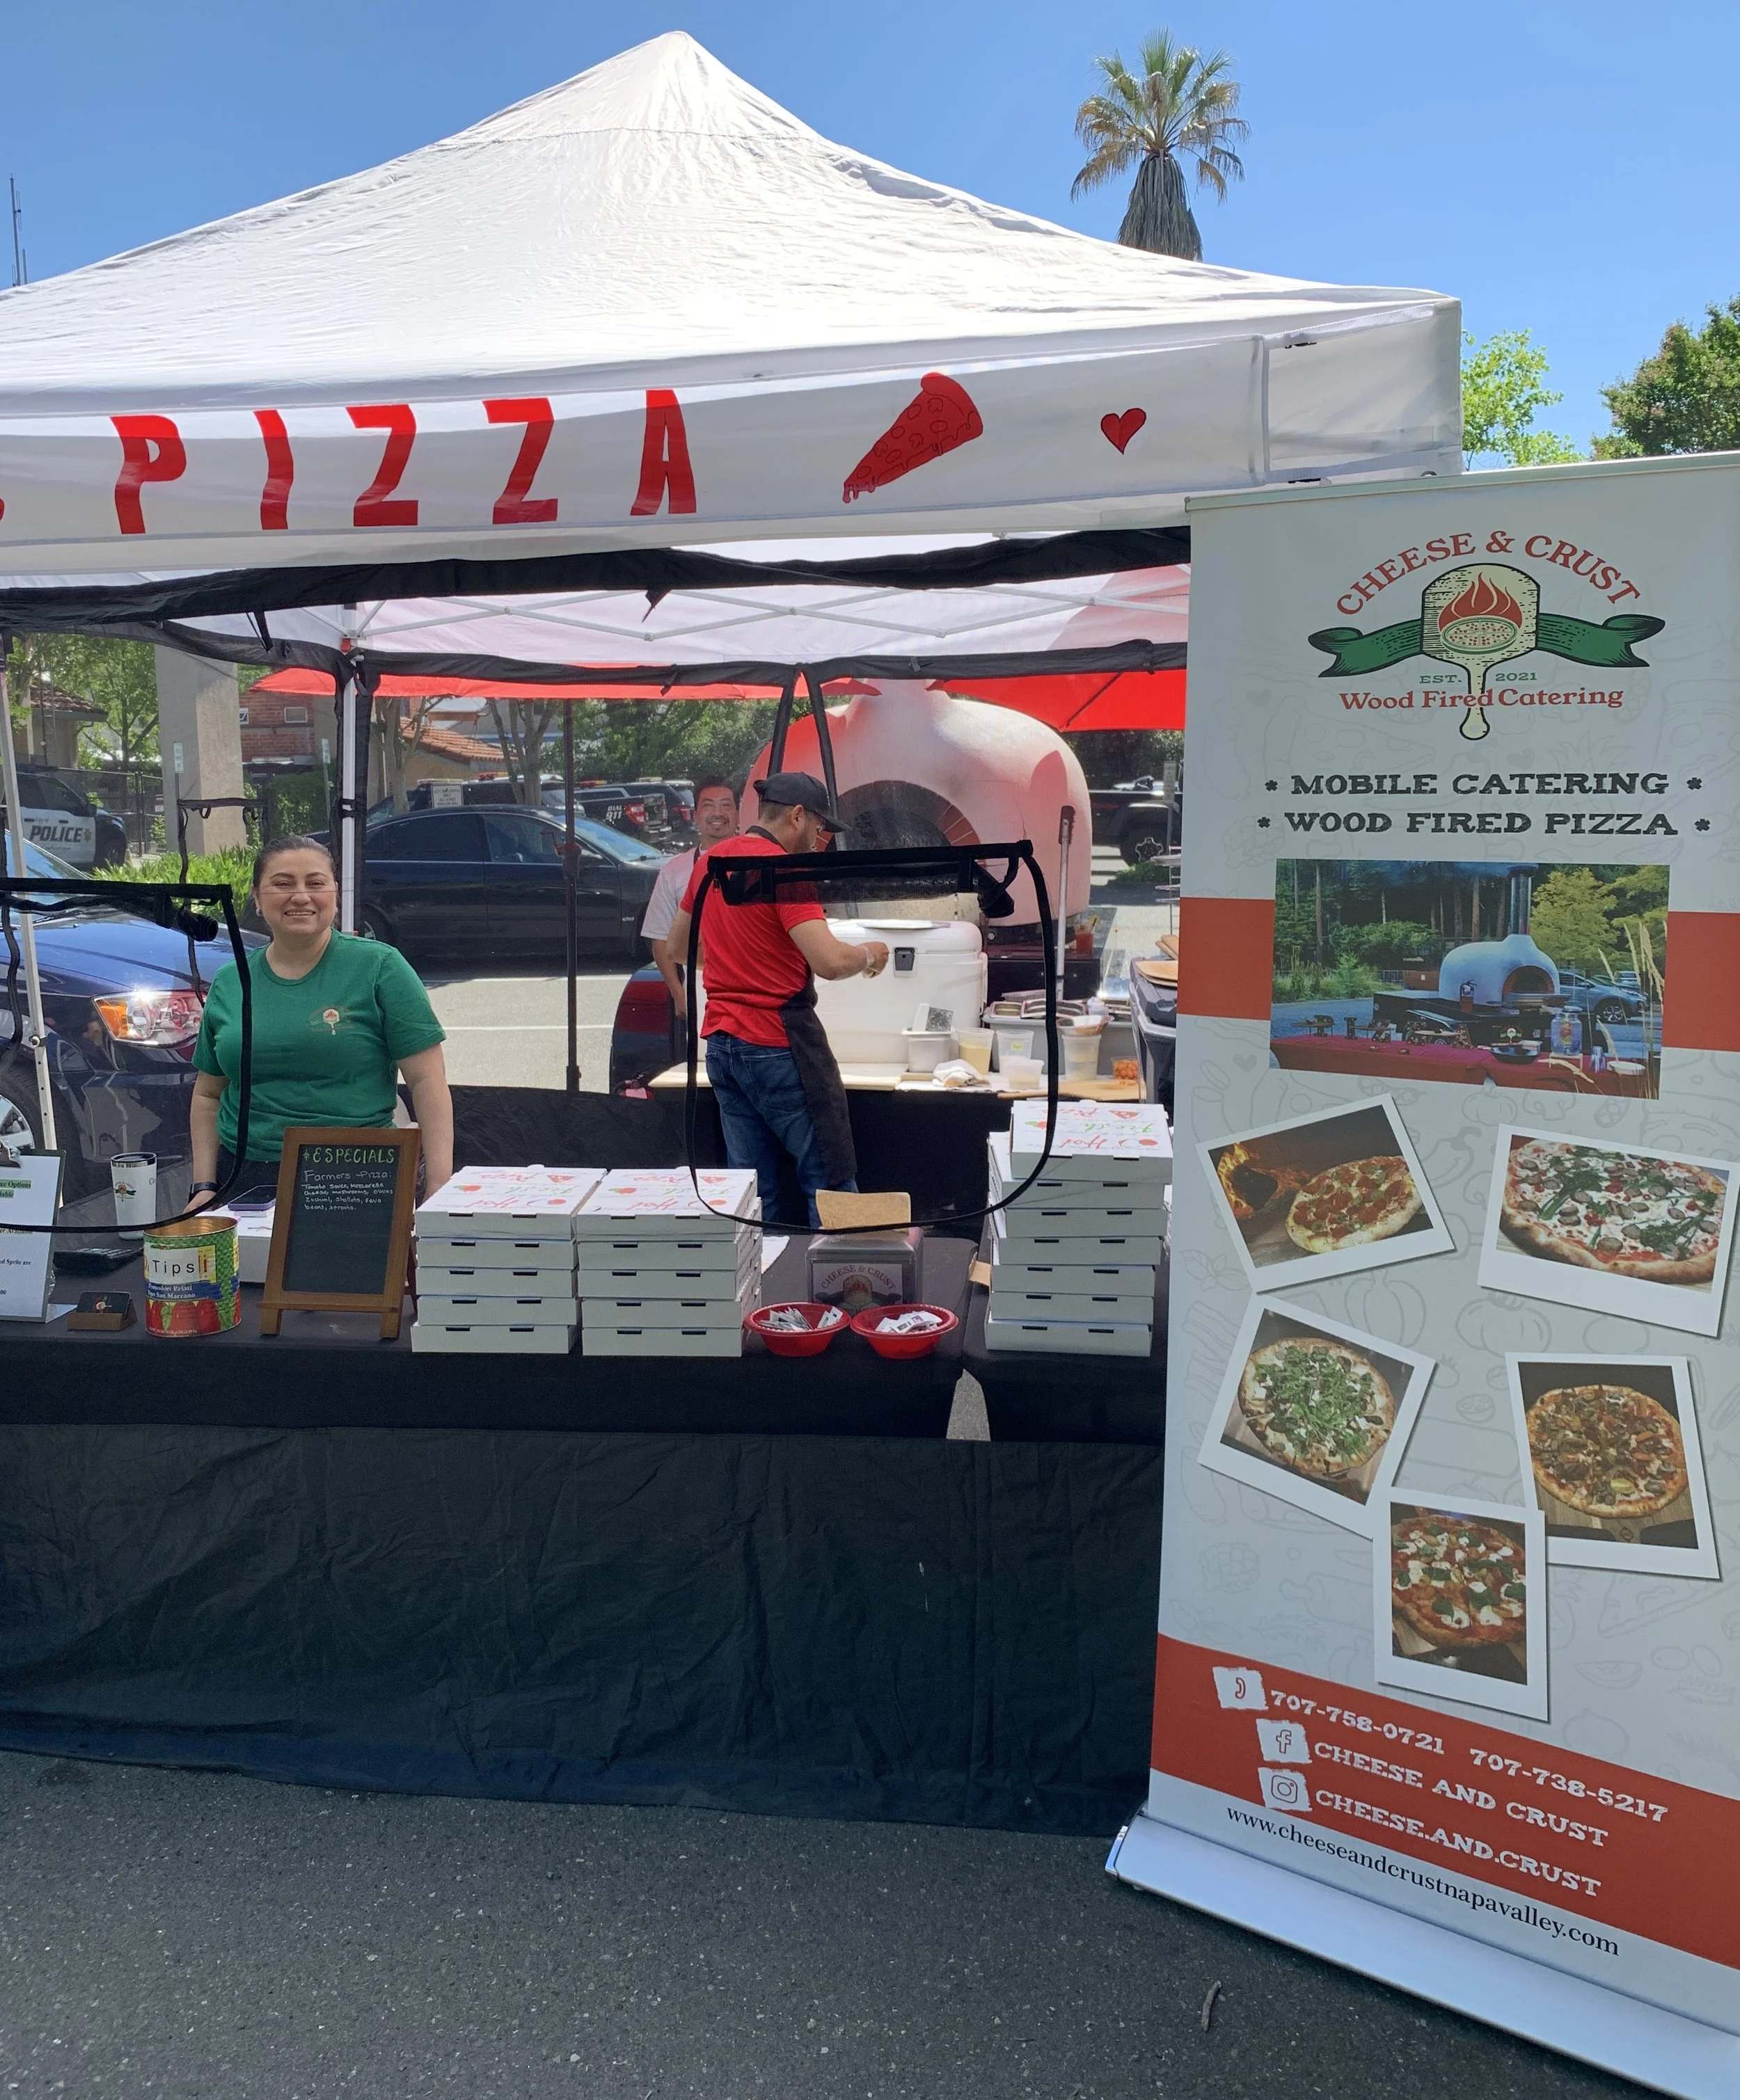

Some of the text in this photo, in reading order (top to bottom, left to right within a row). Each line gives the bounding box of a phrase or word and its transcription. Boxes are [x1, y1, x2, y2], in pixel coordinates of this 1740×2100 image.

[109, 389, 696, 534] PIZZA
[1336, 530, 1641, 615] CHEESE & CRUST
[1420, 671, 1537, 684] EST. 2021
[1339, 686, 1624, 710] Wood Fired Catering
[1290, 772, 1669, 795] MOBILE CATERING
[606, 811, 622, 820] 911
[1285, 812, 1678, 835] WOOD FIRED PIZZA
[30, 825, 83, 842] POLICE
[303, 1170, 351, 1182] Farmers
[152, 1259, 195, 1277] Tips
[821, 1265, 856, 1289] CHEESE
[867, 1266, 896, 1289] CRUST
[1270, 1689, 1668, 1822] 707-758-0721 707-738-5217
[1314, 1742, 1608, 1847] CHEESE AND CRUST
[1226, 1807, 1620, 1957] www.cheeseandcrustnapavalley.com
